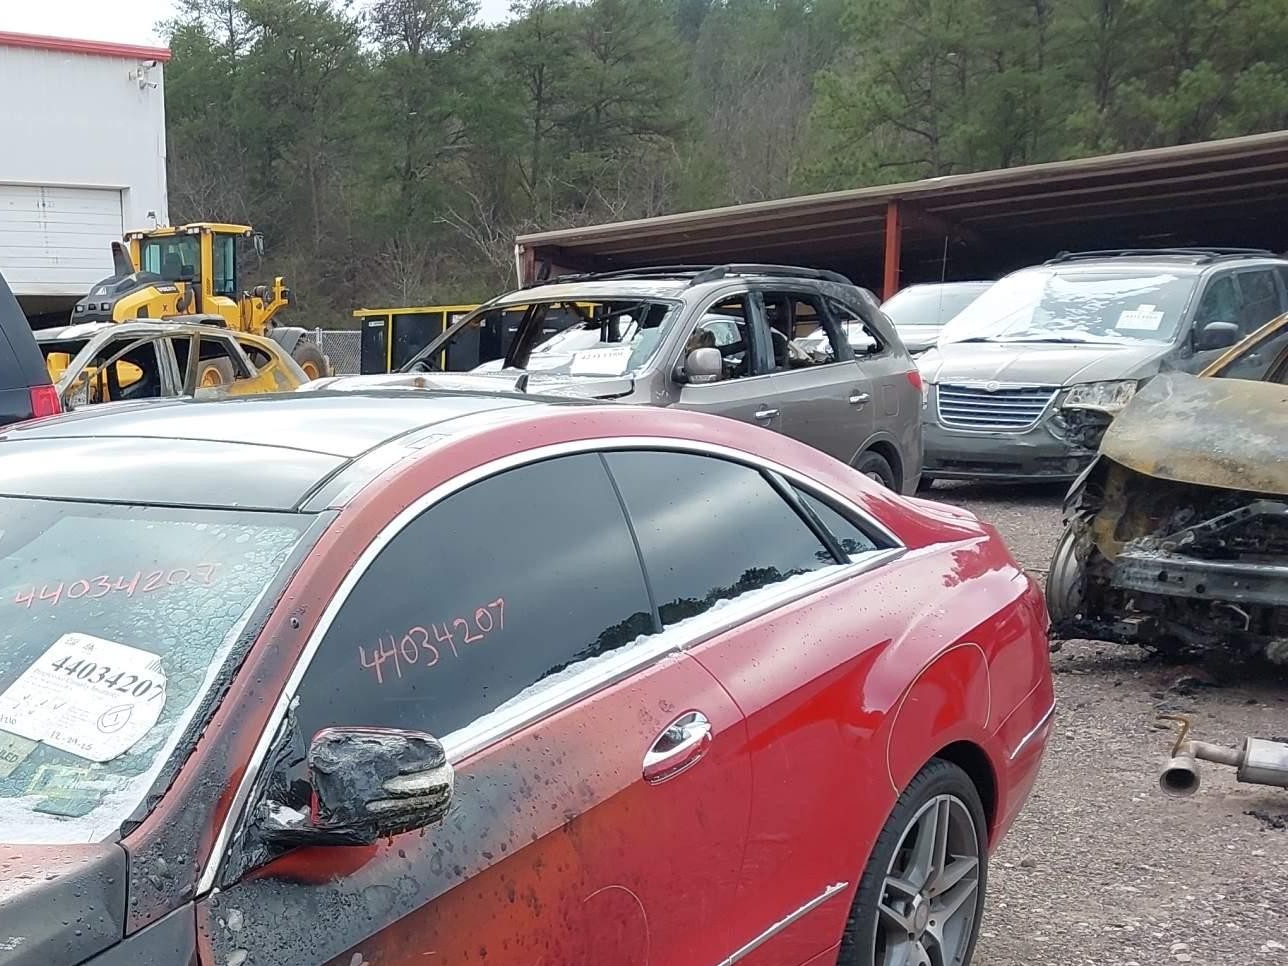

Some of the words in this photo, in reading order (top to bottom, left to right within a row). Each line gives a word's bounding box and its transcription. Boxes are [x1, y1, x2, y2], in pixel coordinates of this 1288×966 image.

[15, 562, 219, 608] 44034207
[358, 598, 505, 684] 44034207
[51, 655, 164, 702] 44034207
